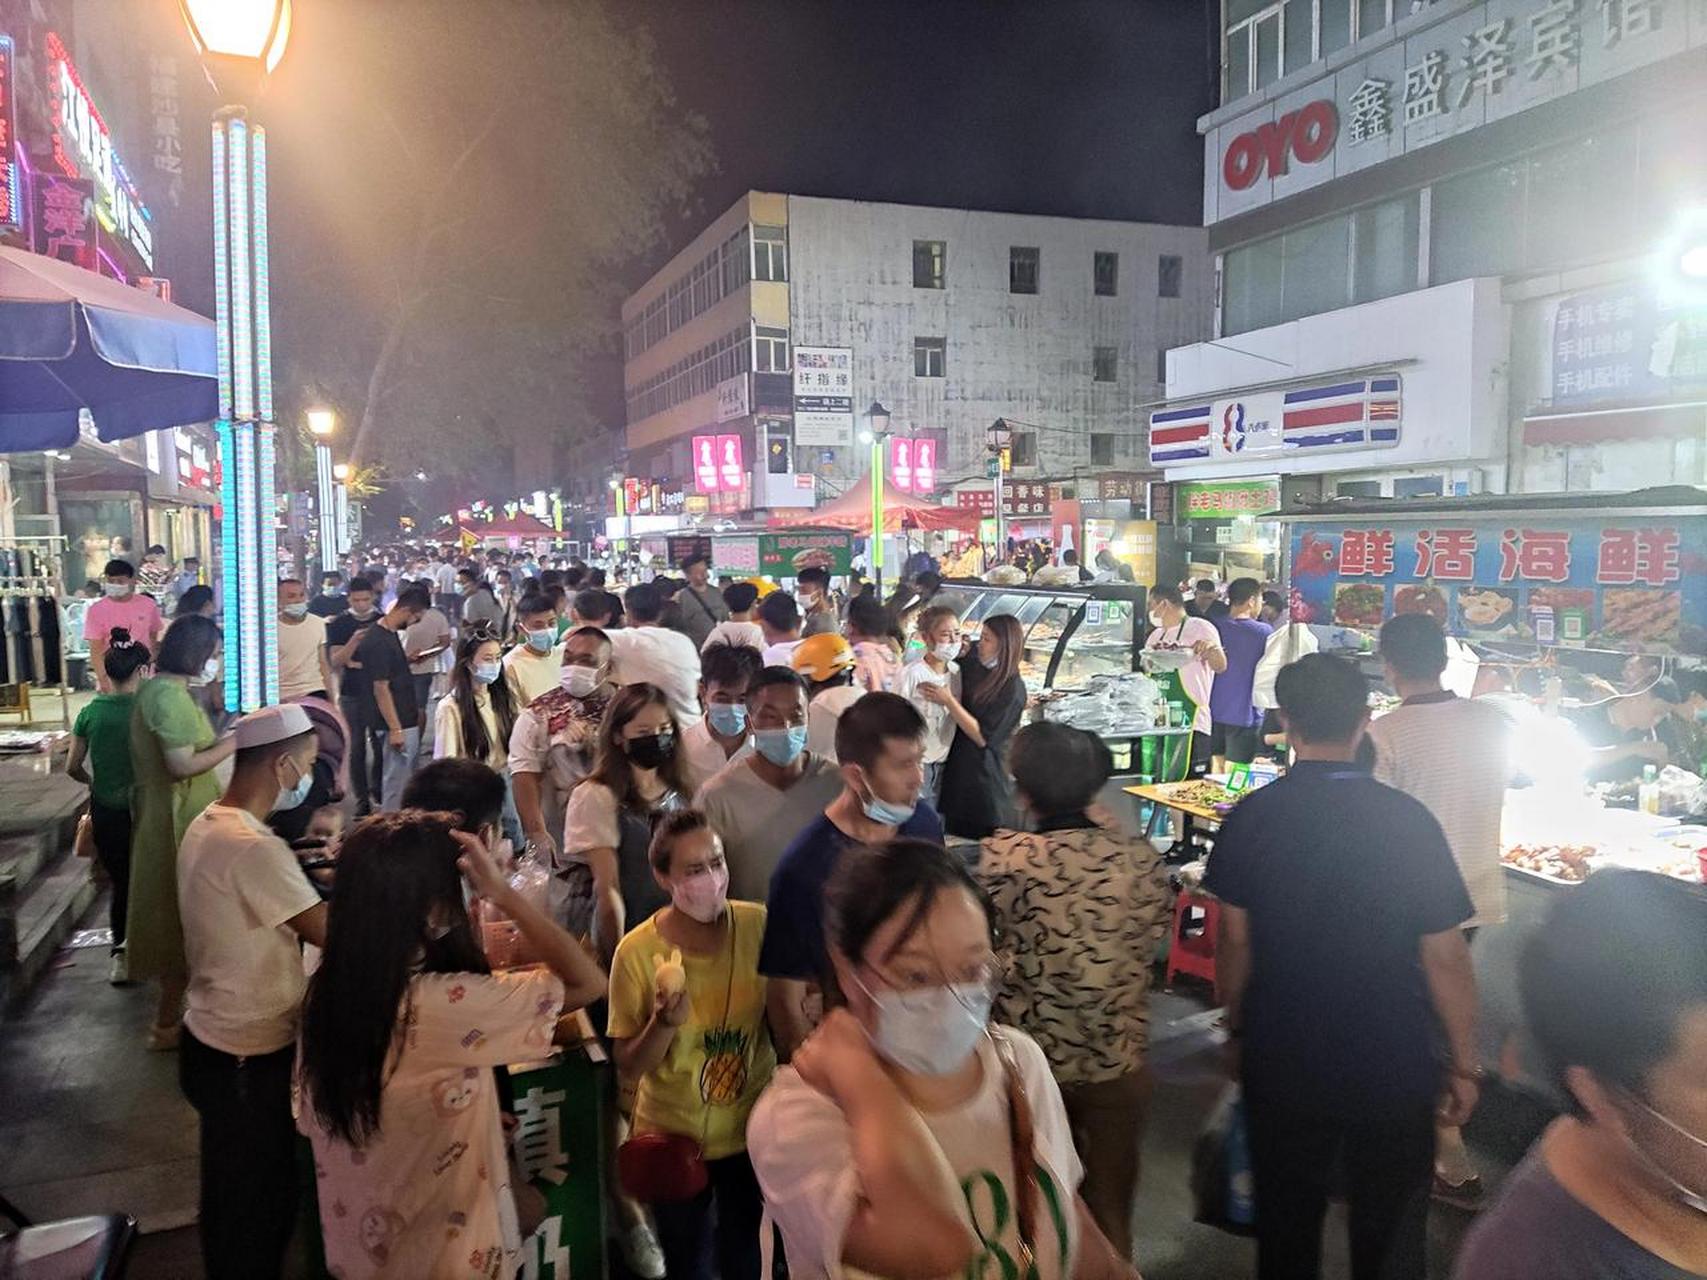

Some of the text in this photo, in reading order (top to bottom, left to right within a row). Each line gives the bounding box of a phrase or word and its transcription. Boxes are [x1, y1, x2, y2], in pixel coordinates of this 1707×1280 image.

[1347, 0, 1662, 146] 鑫盛泽宾馆
[1224, 100, 1337, 191] OYO
[1338, 527, 1681, 586] 鲜活海鲜
